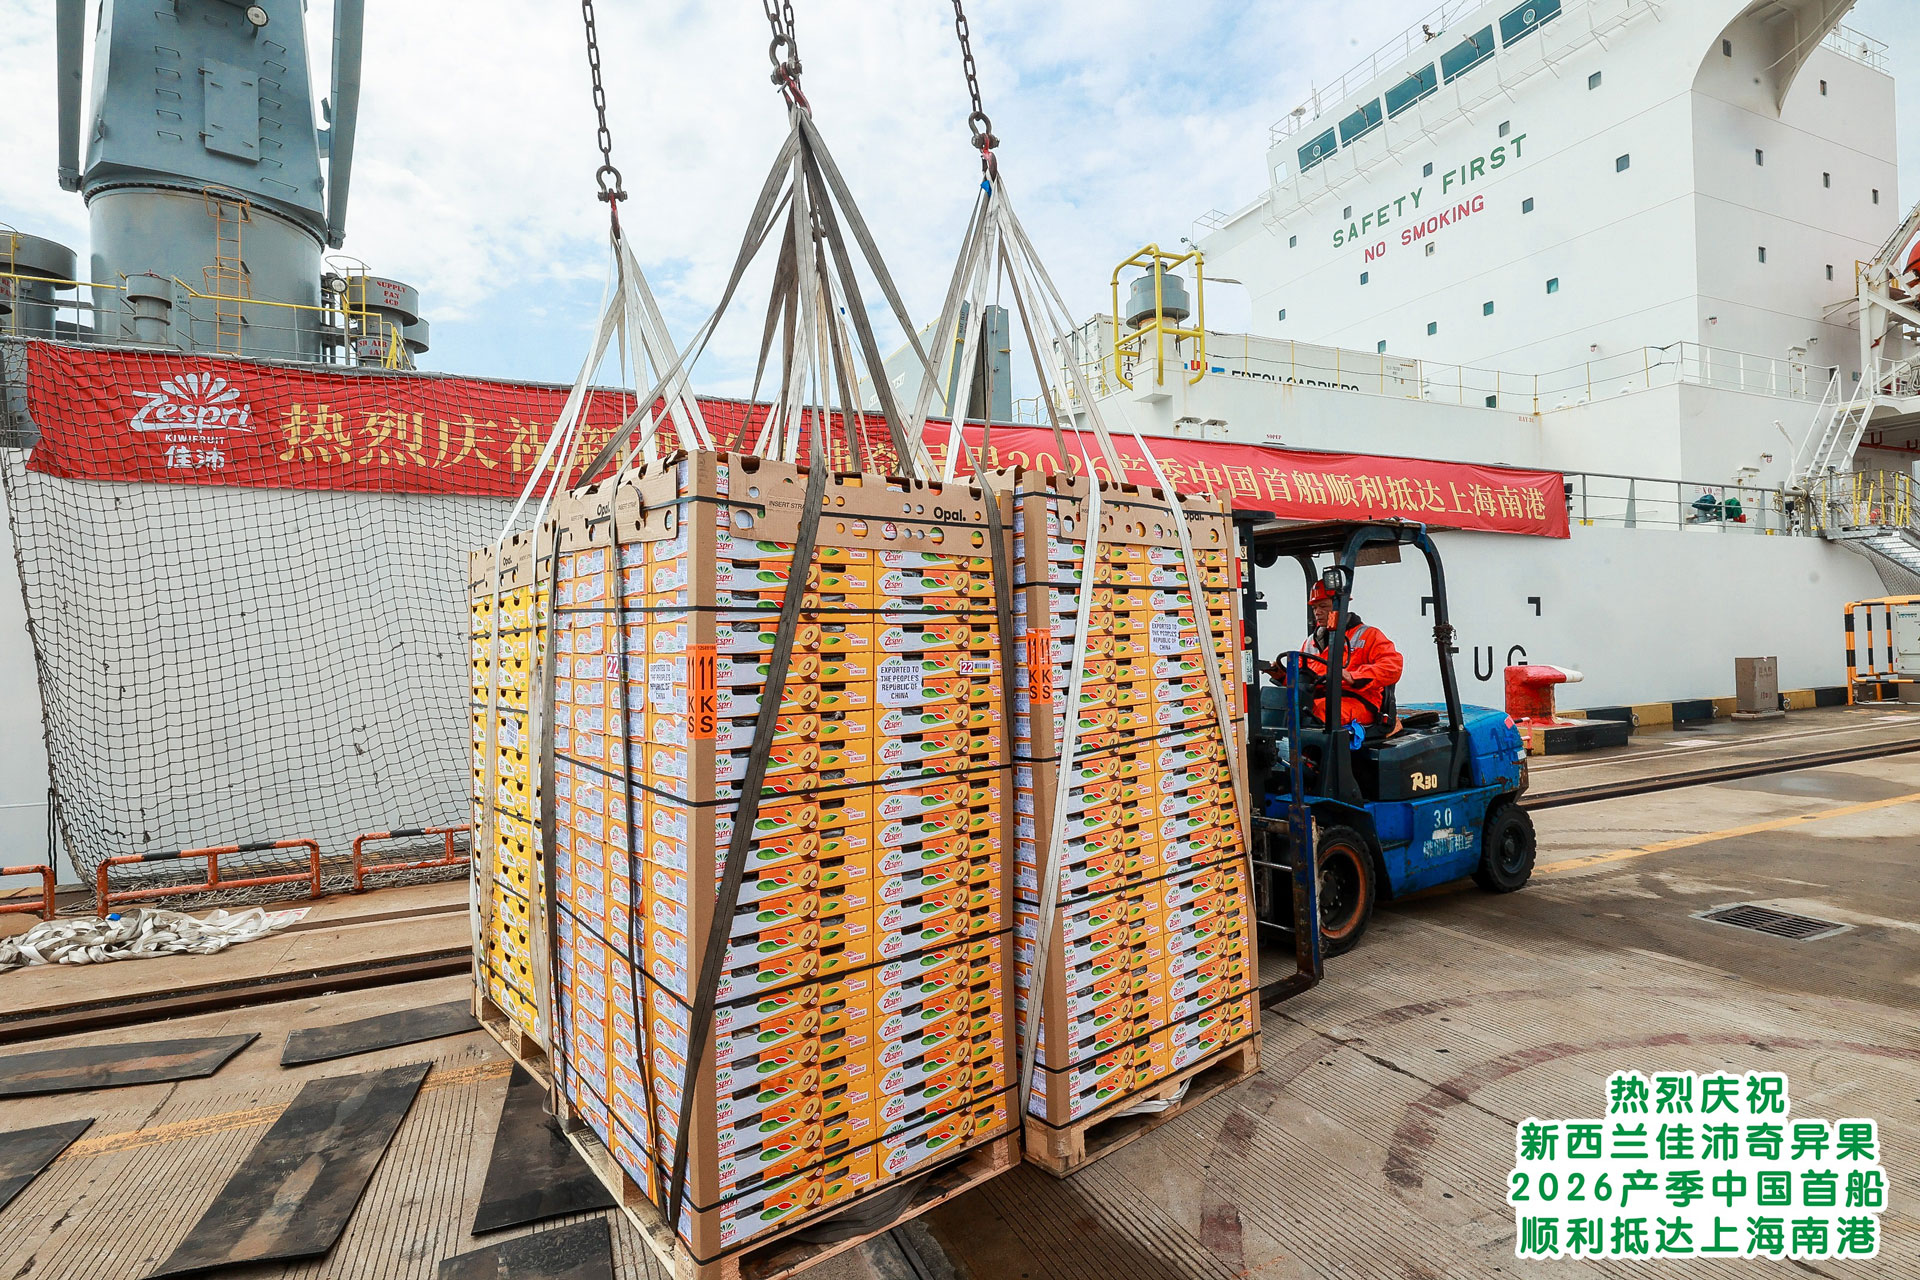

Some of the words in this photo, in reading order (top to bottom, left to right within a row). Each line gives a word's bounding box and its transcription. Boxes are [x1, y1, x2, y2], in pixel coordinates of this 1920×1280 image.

[1333, 188, 1422, 248] SAFETY
[1442, 134, 1526, 194] FIRST
[1363, 240, 1386, 264] NO
[1401, 195, 1484, 246] SMOKING
[377, 281, 406, 293] SUPPLY
[130, 390, 252, 434] Zespri
[166, 434, 224, 445] KIWIFRUIT
[164, 445, 225, 472] 佳沛
[769, 500, 790, 508] INSERT
[790, 502, 805, 510] STRA
[934, 506, 966, 523] Opal.
[716, 542, 733, 551] spri
[885, 552, 903, 561] Zespri
[716, 574, 733, 582] spri
[884, 579, 903, 589] Zespri
[716, 638, 734, 646] spri
[884, 636, 903, 646] Zespri
[1028, 638, 1037, 665] 11
[1040, 638, 1050, 664] 11
[607, 656, 619, 677] 22
[881, 666, 910, 674] EXPORTED
[961, 662, 974, 673] 22
[688, 656, 695, 690] 11
[700, 656, 714, 690] 11
[717, 670, 732, 679] spri
[1029, 670, 1038, 683] K
[1042, 669, 1051, 683] K
[1030, 685, 1037, 699] S
[1043, 685, 1050, 699] S
[688, 696, 695, 713] K
[700, 696, 714, 713] K
[717, 701, 732, 710] spri
[688, 716, 695, 733] S
[700, 716, 713, 733] S
[884, 720, 902, 730] Zespri
[717, 733, 732, 742] spri
[884, 748, 903, 758] Zespri
[716, 766, 732, 775] spri
[1410, 772, 1438, 791] R30
[884, 804, 903, 815] Zespri
[1434, 808, 1452, 828] 30
[716, 830, 732, 838] spri
[884, 831, 903, 842] Zespri
[884, 859, 903, 870] Zespri
[884, 886, 903, 898] Zespri
[883, 913, 902, 925] Zespri
[884, 941, 903, 953] Zespri
[883, 968, 902, 981] Zespri
[716, 986, 732, 994] spri
[884, 996, 902, 1008] Zespri
[716, 1017, 733, 1025] spri
[884, 1024, 903, 1036] Zespri
[716, 1048, 733, 1058] spri
[884, 1050, 903, 1062] Zespri
[716, 1079, 733, 1089] spri
[885, 1077, 904, 1090] Zespri
[717, 1109, 733, 1119] spri
[886, 1104, 905, 1117] Zespri
[718, 1138, 735, 1148] spri
[890, 1154, 908, 1168] Zespri
[719, 1170, 736, 1180] spri
[720, 1199, 740, 1210] spri
[721, 1229, 736, 1239] spri
